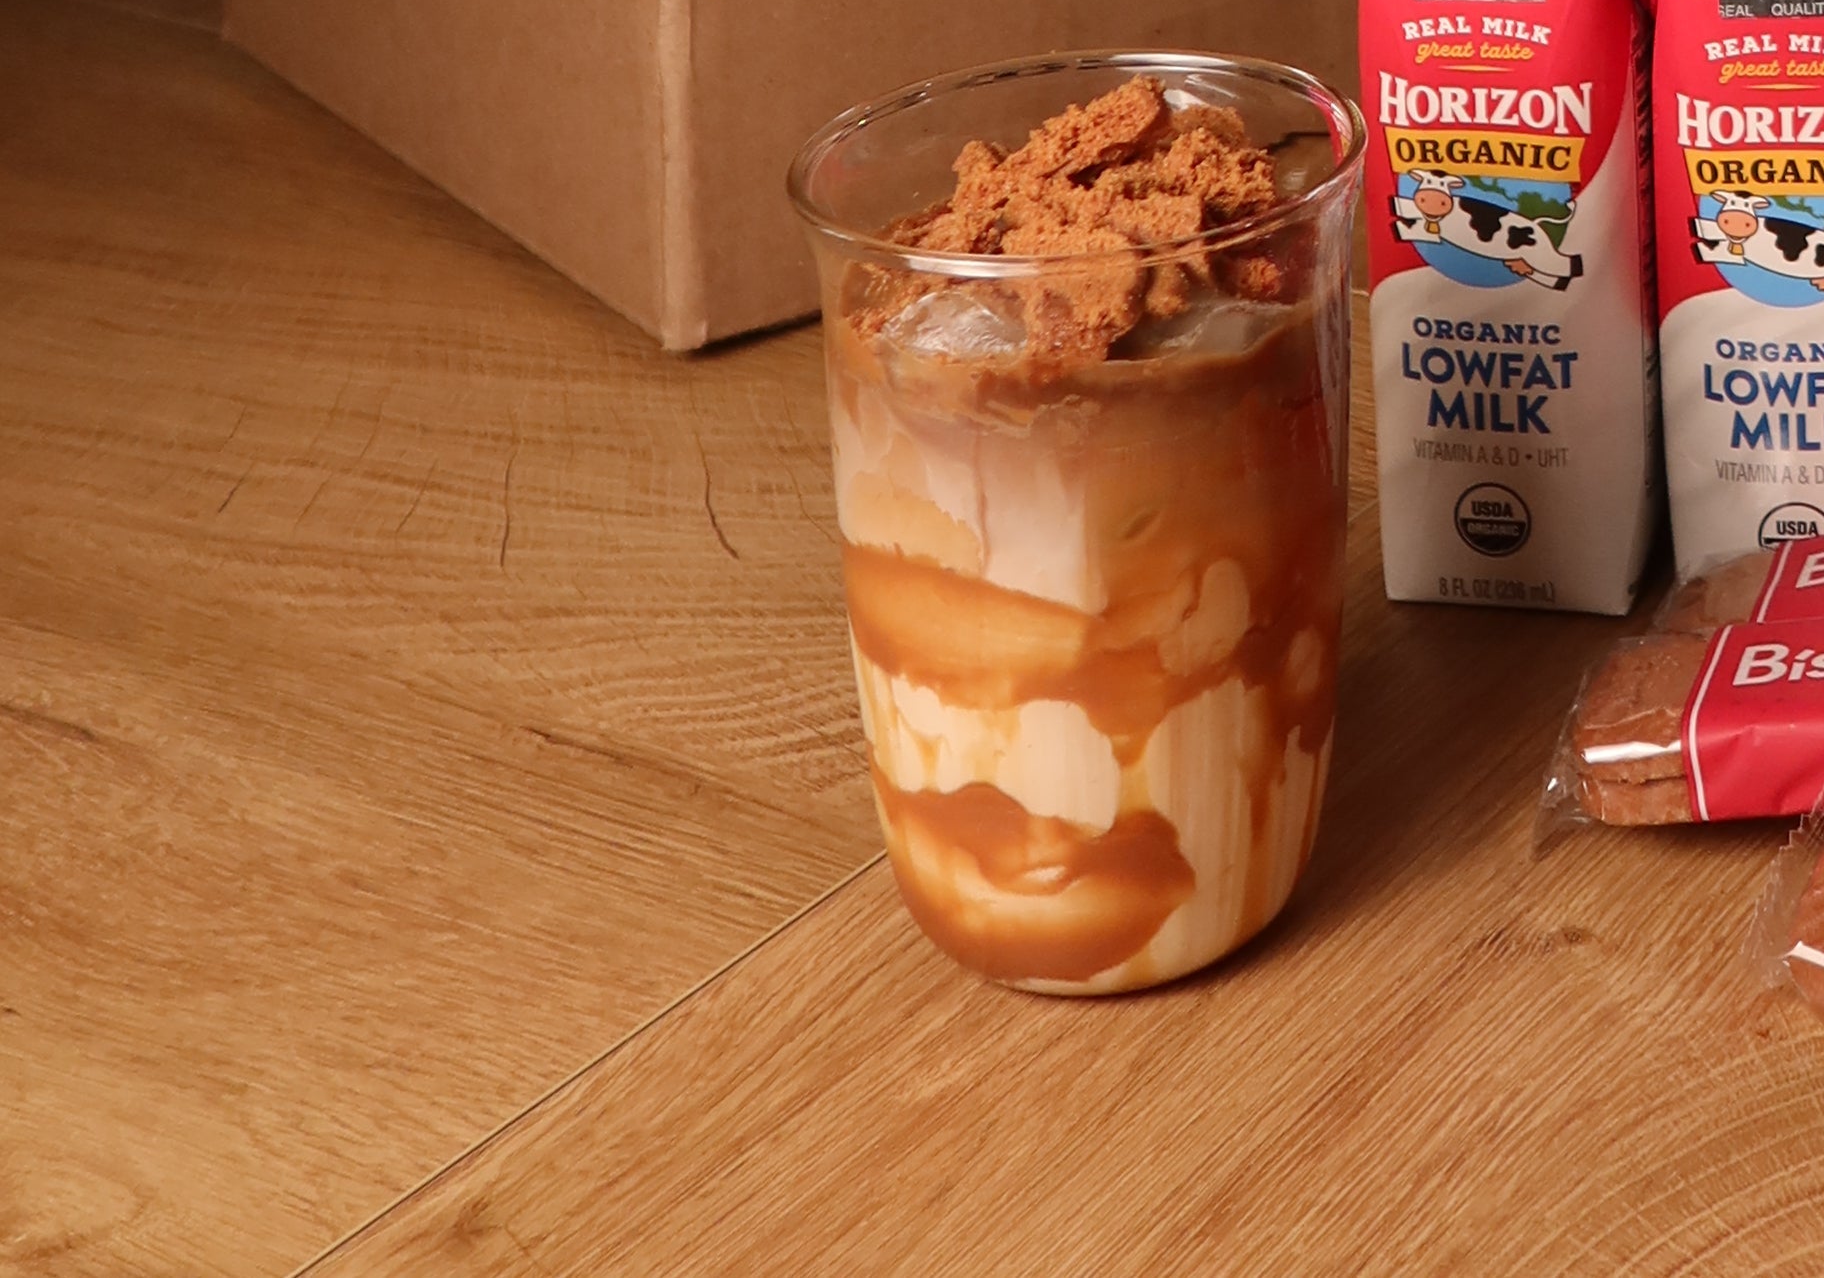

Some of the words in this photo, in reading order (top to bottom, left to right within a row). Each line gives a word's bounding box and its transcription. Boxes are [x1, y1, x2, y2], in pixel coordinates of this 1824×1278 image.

[1402, 14, 1472, 41] REAL
[1481, 16, 1552, 45] MILK
[1415, 41, 1475, 63] great
[1479, 43, 1534, 61] taste
[1704, 32, 1777, 61] REAL
[1719, 57, 1790, 86] great
[1378, 71, 1592, 136] HORIZON
[1393, 135, 1573, 172] ORGANIC
[1412, 316, 1562, 345] ORGANIC
[1402, 341, 1578, 390] LOWFAT
[1427, 389, 1551, 435] MILK
[1413, 437, 1474, 463] VITAMIN
[1476, 446, 1489, 464] A
[1491, 447, 1505, 466] &
[1508, 447, 1520, 466] D
[1537, 447, 1570, 468] UHT
[1714, 458, 1778, 484] VITAMIN
[1781, 462, 1795, 485] A
[1797, 463, 1811, 484] &
[1471, 500, 1514, 518] USDA
[1776, 519, 1819, 537] USDA
[1454, 578, 1470, 597] FL
[1473, 578, 1491, 598] OZ
